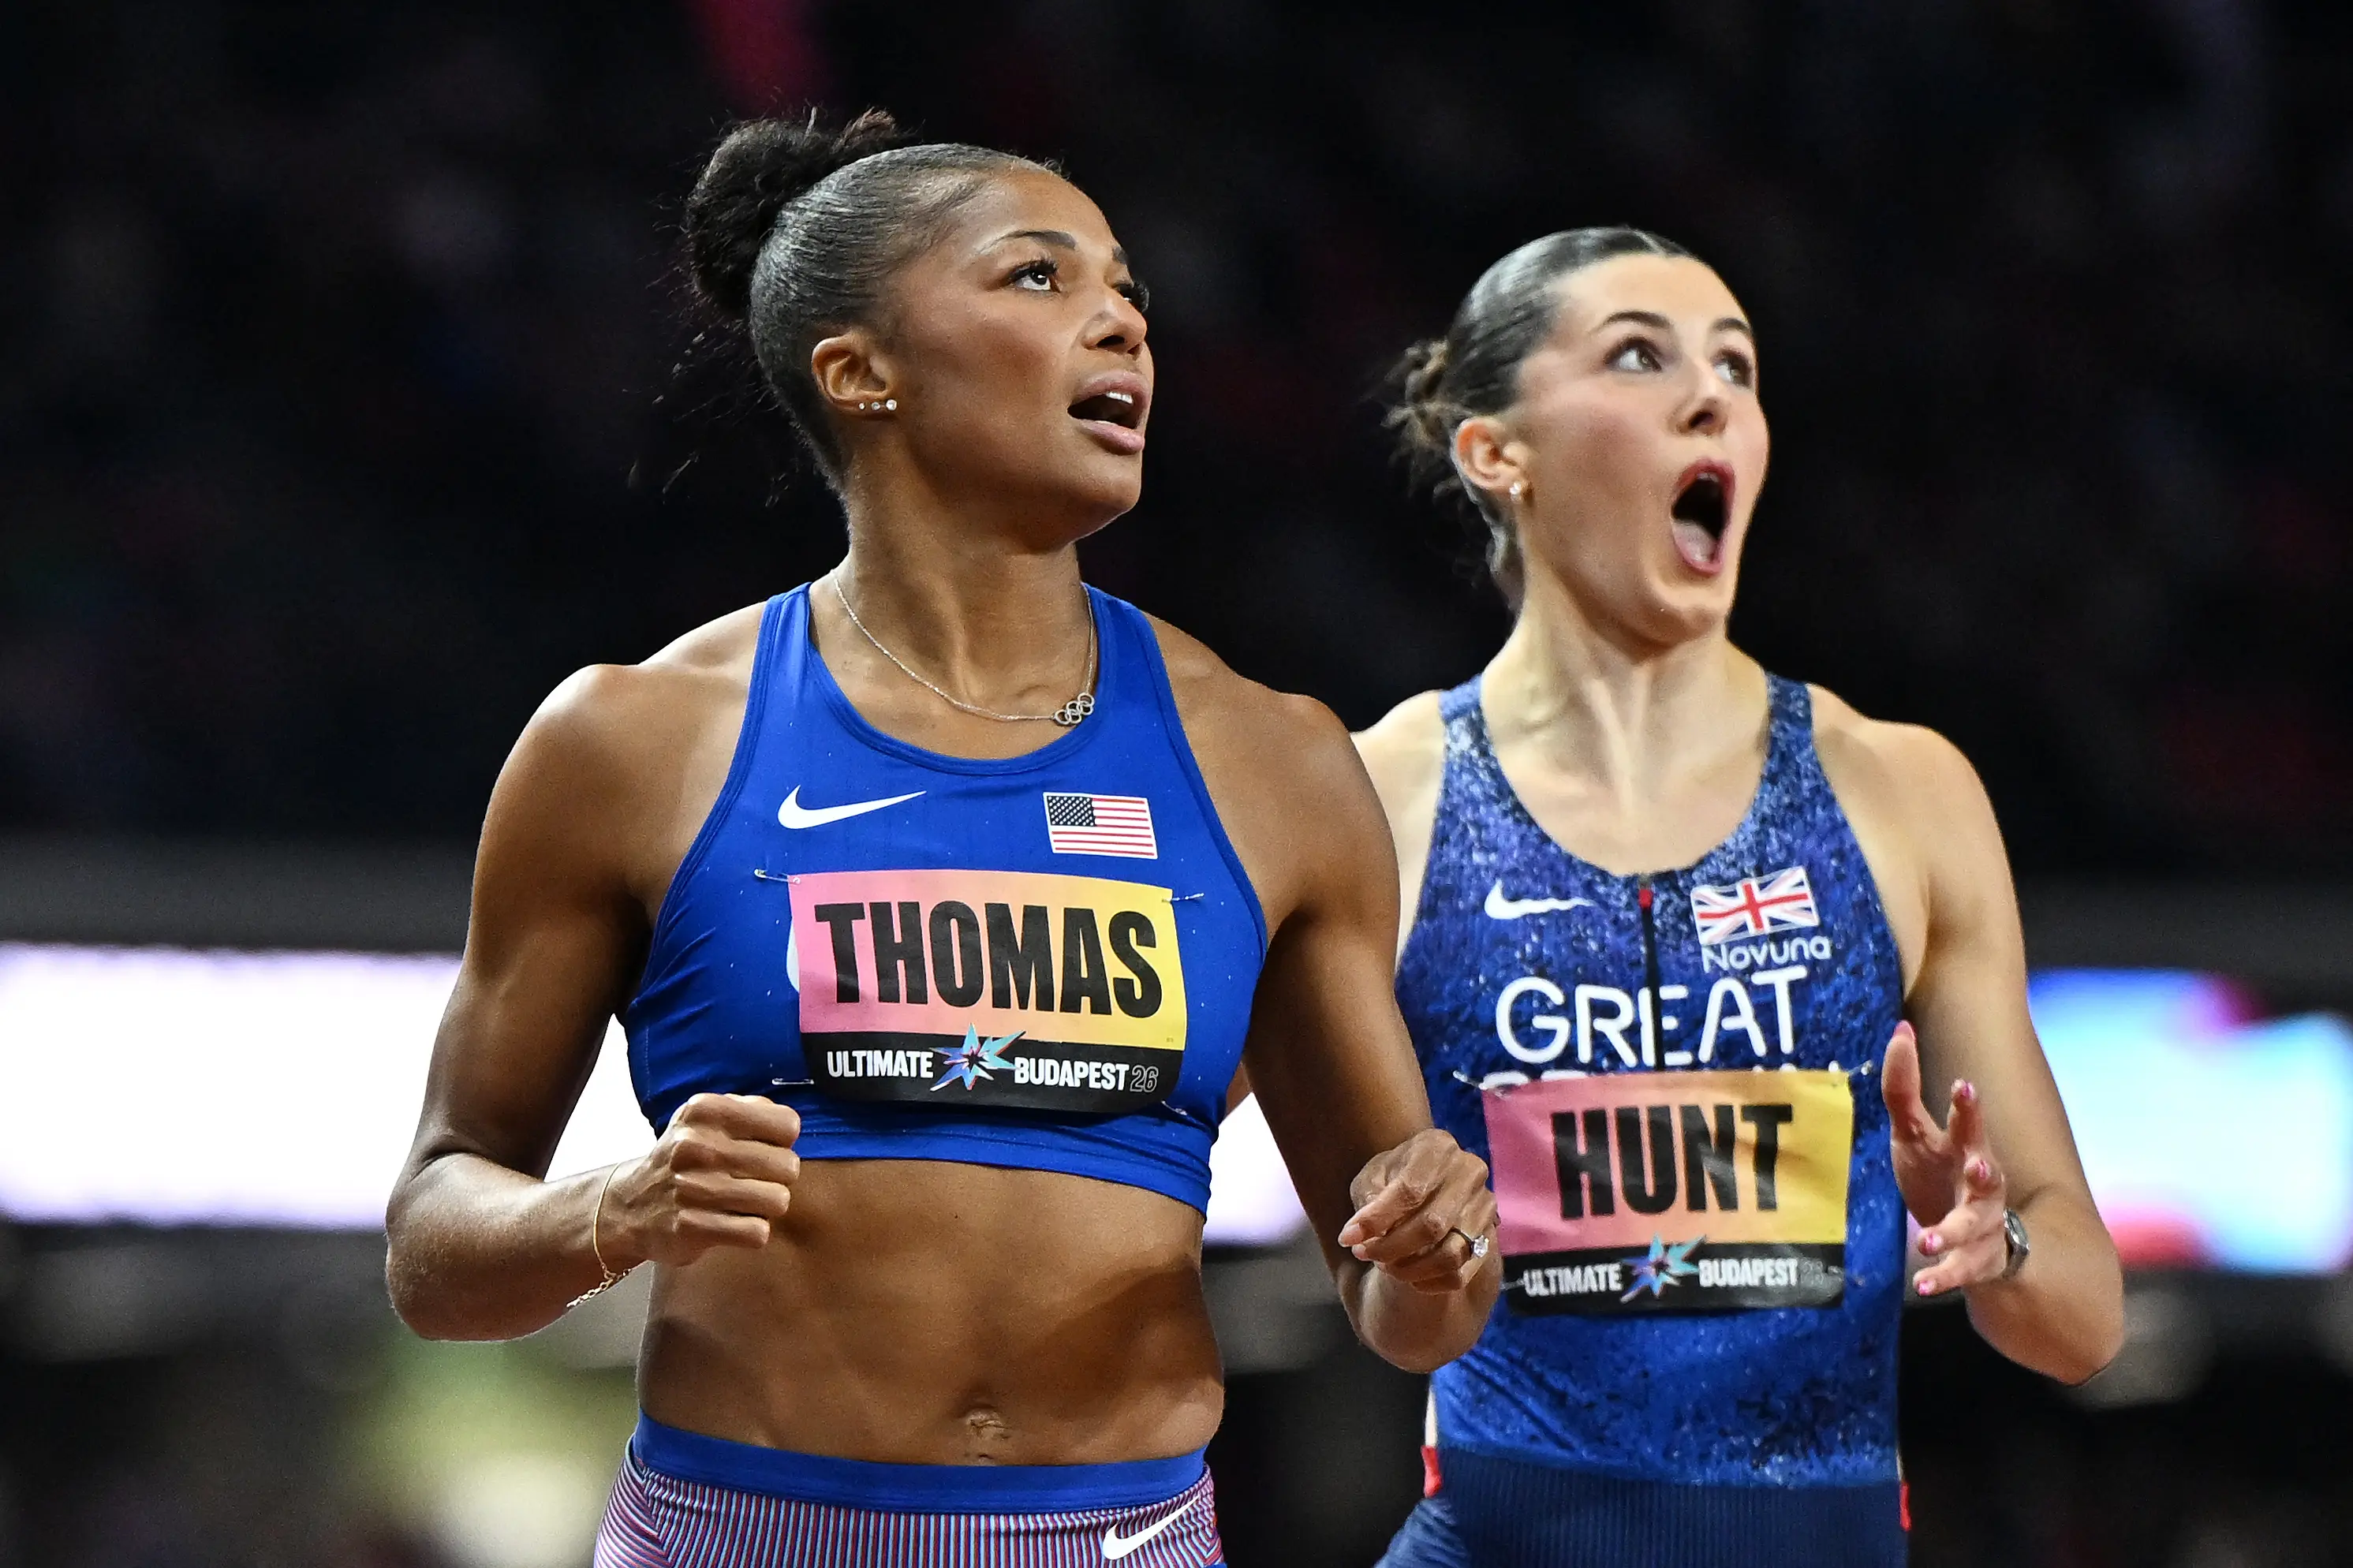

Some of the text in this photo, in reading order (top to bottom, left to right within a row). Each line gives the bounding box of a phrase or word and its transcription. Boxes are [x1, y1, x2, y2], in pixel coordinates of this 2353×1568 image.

[814, 900, 1163, 1019] THOMAS
[1702, 935, 1832, 973] Novuna
[1496, 965, 1808, 1067] GREAT
[826, 1050, 1160, 1093] ULTIMATE BUDAPEST 26
[1551, 1103, 1793, 1219] HUNT
[1523, 1263, 1623, 1297] ULTIMATE
[1698, 1258, 1798, 1288] BUDAPEST
